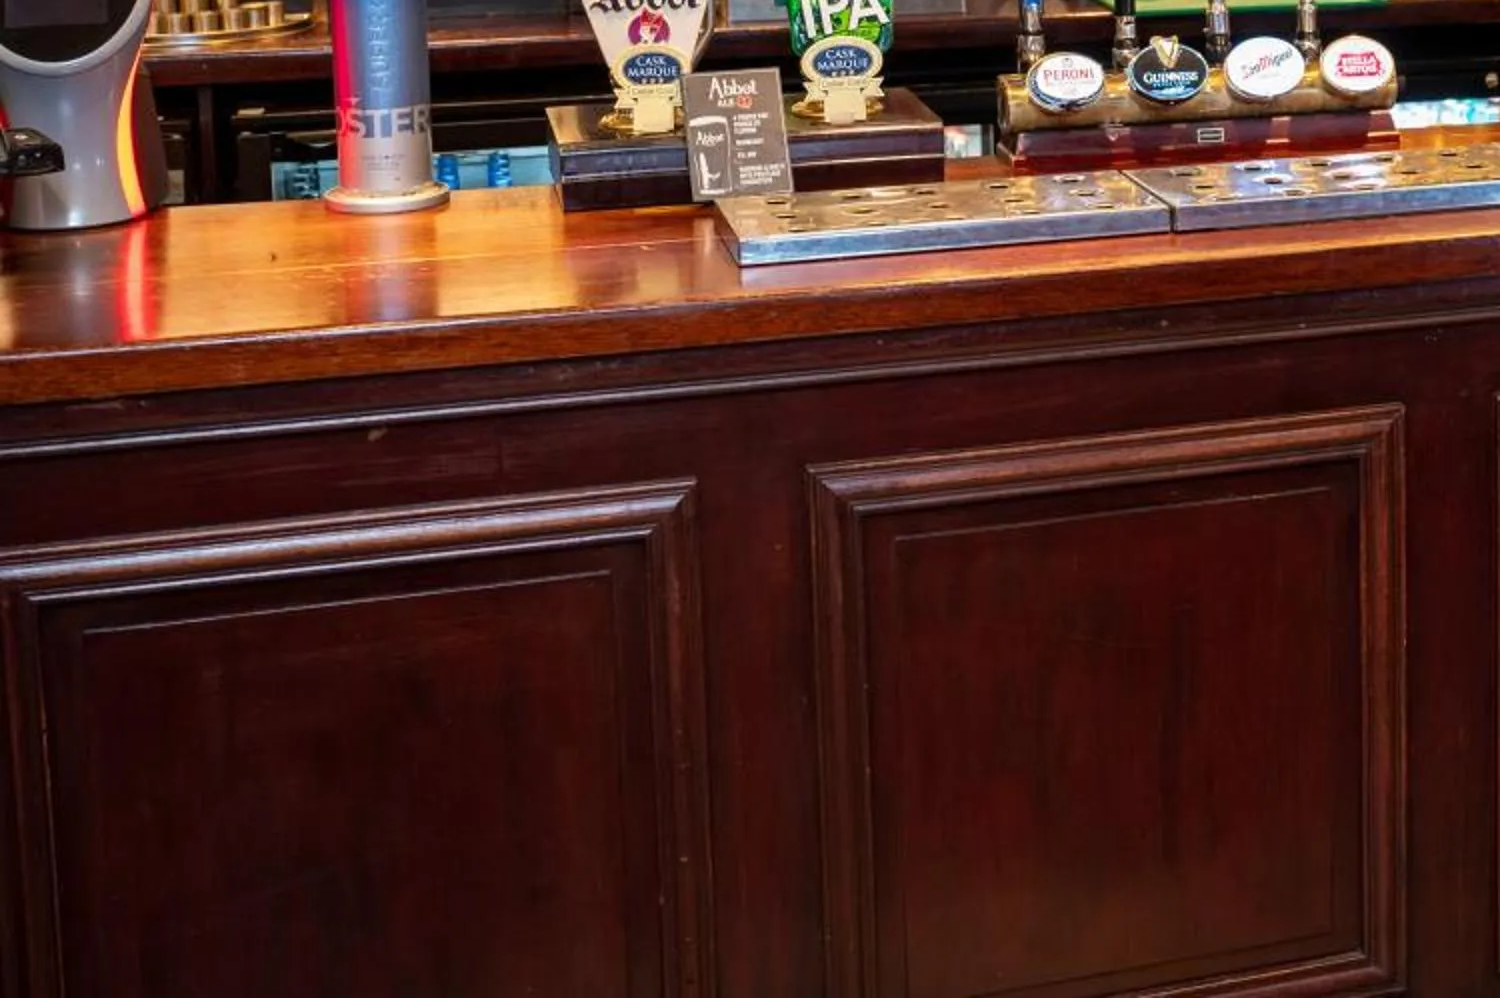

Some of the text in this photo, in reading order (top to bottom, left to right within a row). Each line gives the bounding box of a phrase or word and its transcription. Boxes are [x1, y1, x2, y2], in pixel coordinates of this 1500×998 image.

[825, 50, 857, 60] CASK
[636, 56, 666, 67] CASK
[817, 58, 868, 70] MARQUE
[627, 66, 679, 77] MARQUE
[1043, 68, 1095, 82] PERONI
[1143, 71, 1200, 84] GUINNESS
[709, 77, 758, 100] Abbot
